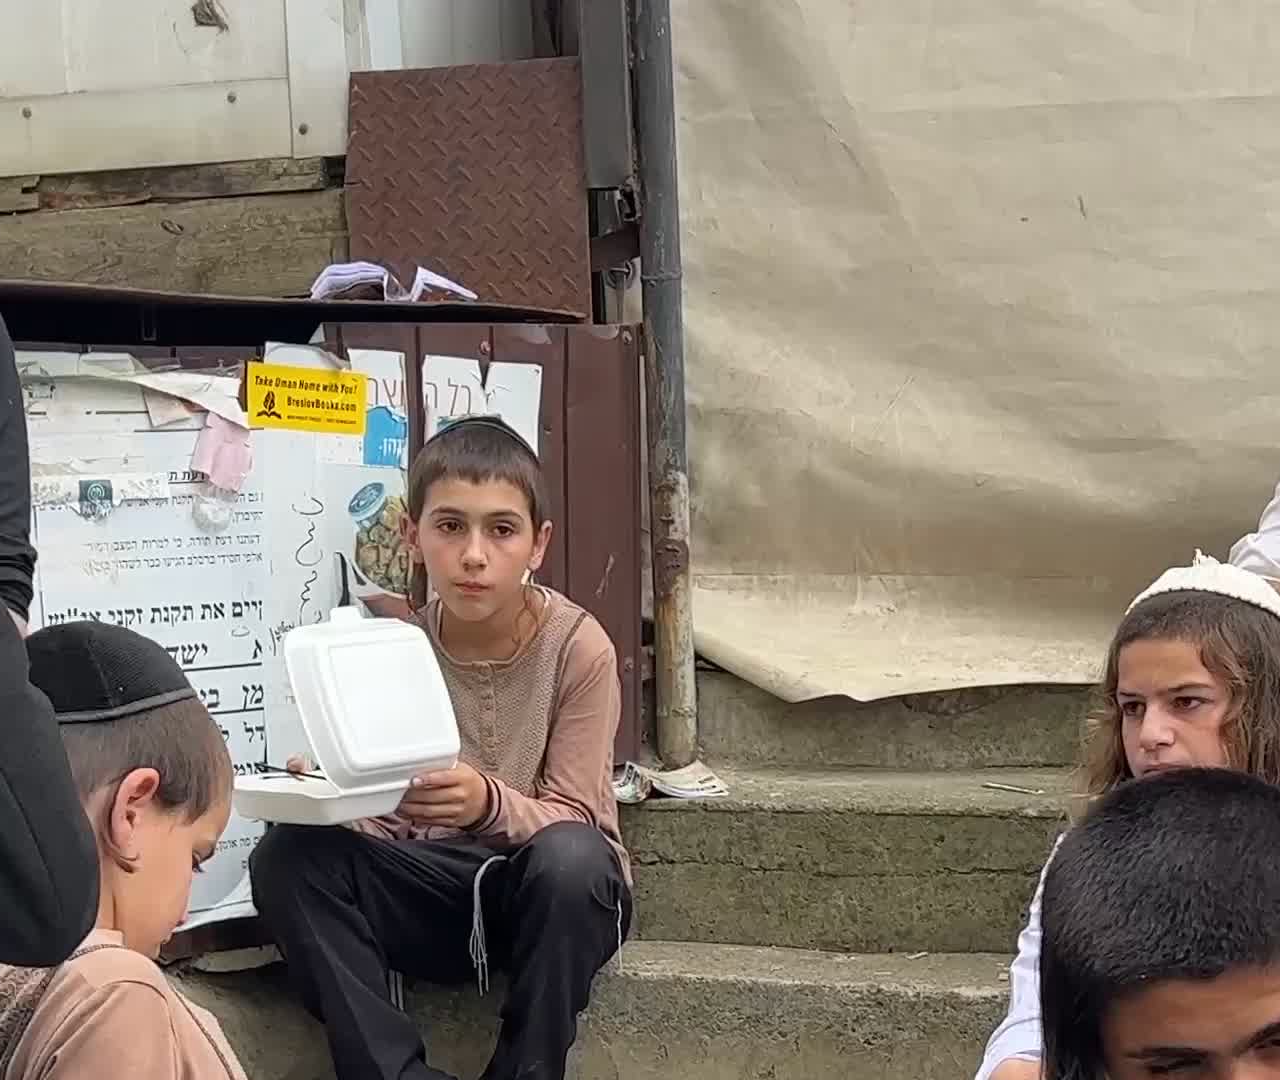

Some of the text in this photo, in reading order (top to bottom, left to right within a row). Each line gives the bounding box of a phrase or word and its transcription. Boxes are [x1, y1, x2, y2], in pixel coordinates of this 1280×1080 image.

[255, 375, 273, 387] Take
[299, 380, 321, 391] Home
[322, 382, 339, 394] with
[286, 396, 357, 412] BreslovBooks.com
[150, 607, 194, 627] תקנת
[200, 602, 224, 620] את
